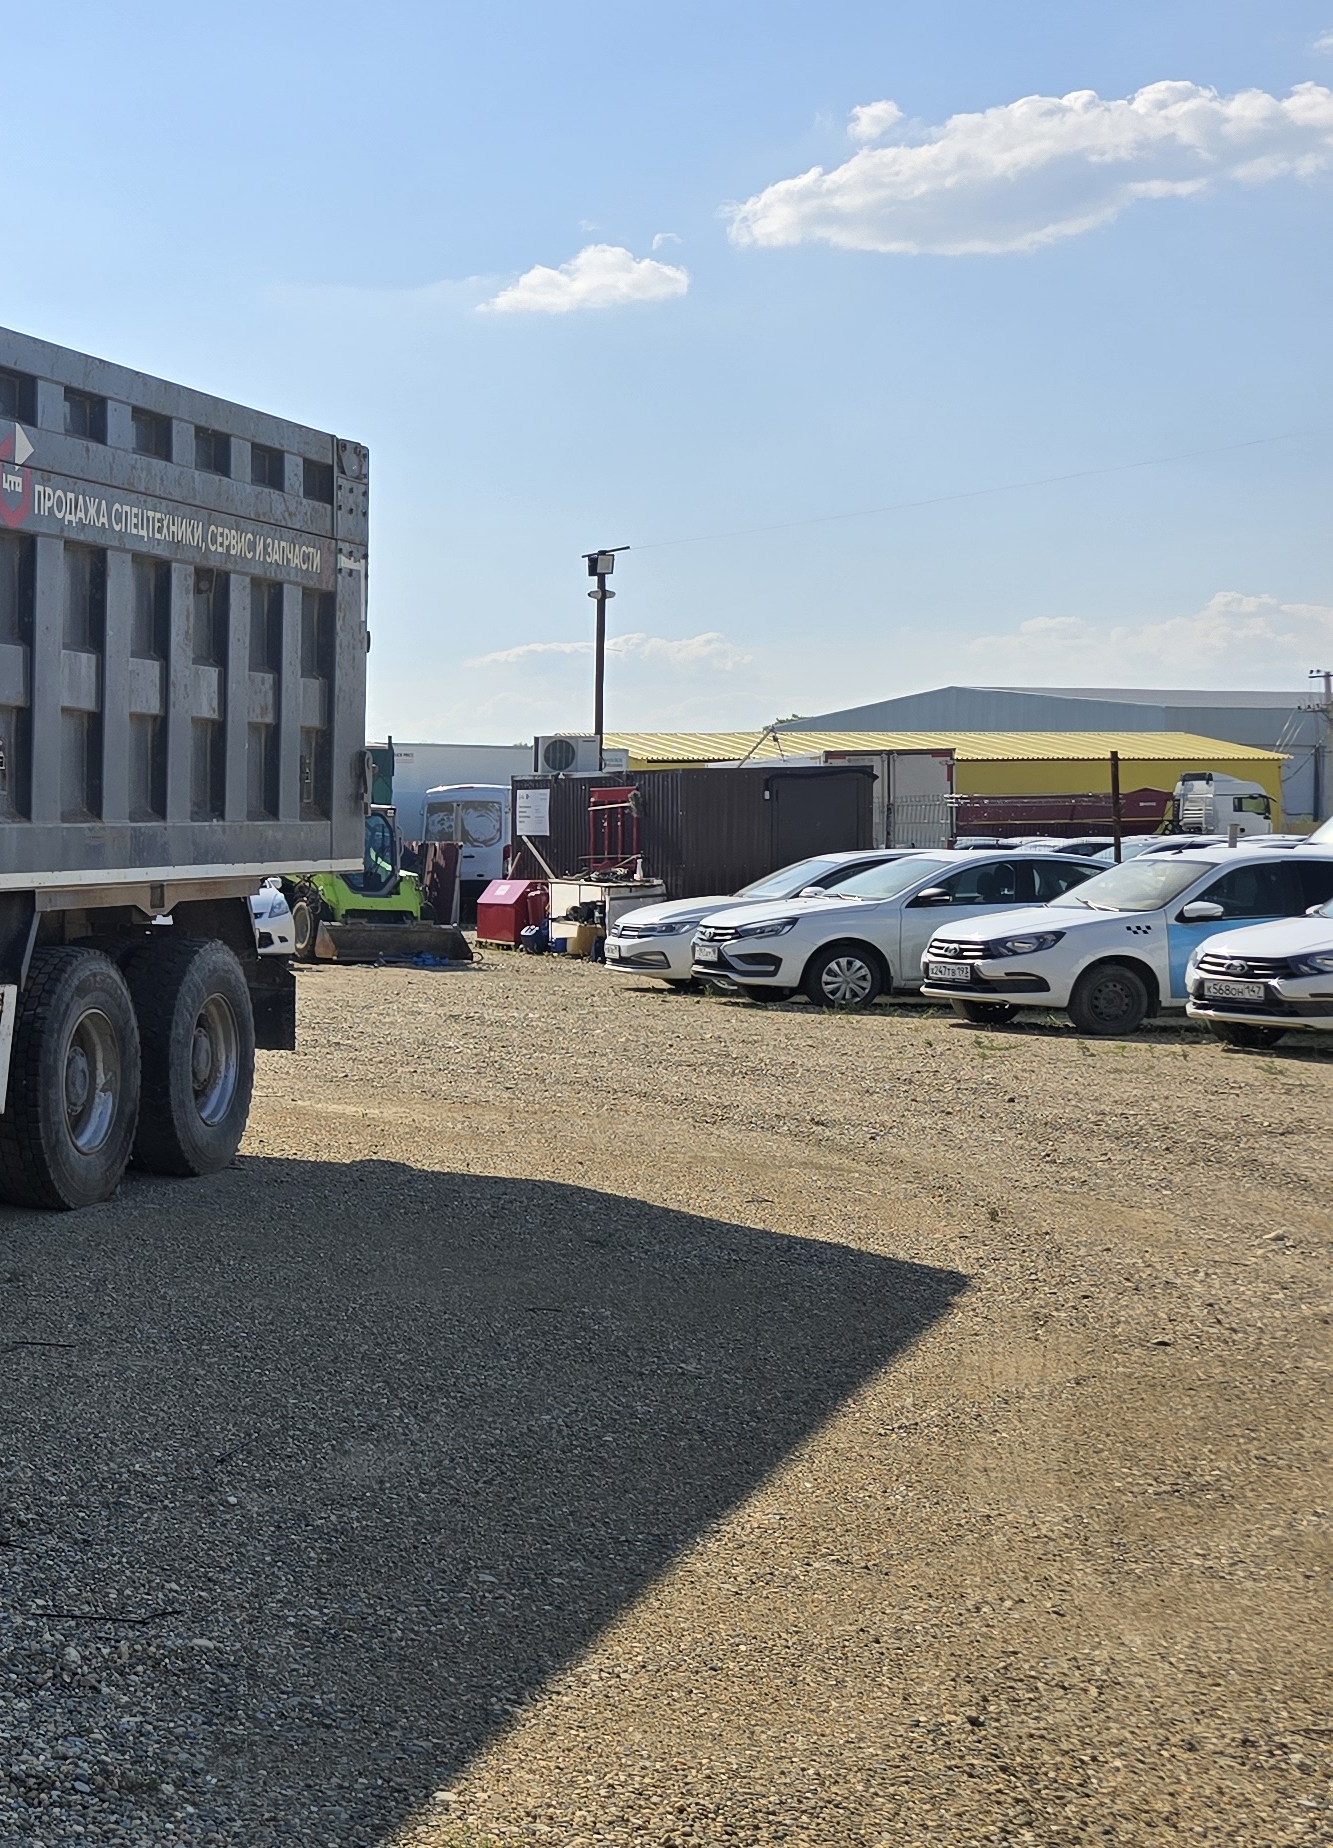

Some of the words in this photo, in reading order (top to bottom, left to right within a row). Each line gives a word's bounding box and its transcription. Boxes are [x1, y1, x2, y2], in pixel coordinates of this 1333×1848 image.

[34, 484, 109, 529] ПРОДАЖА
[111, 502, 206, 553] СПЕЦТЕХНИКИ,
[207, 524, 254, 560] СЕРВИС
[255, 532, 264, 562] И
[265, 537, 322, 574] ЗАПЧАСТИ
[1206, 983, 1244, 997] К568ОН
